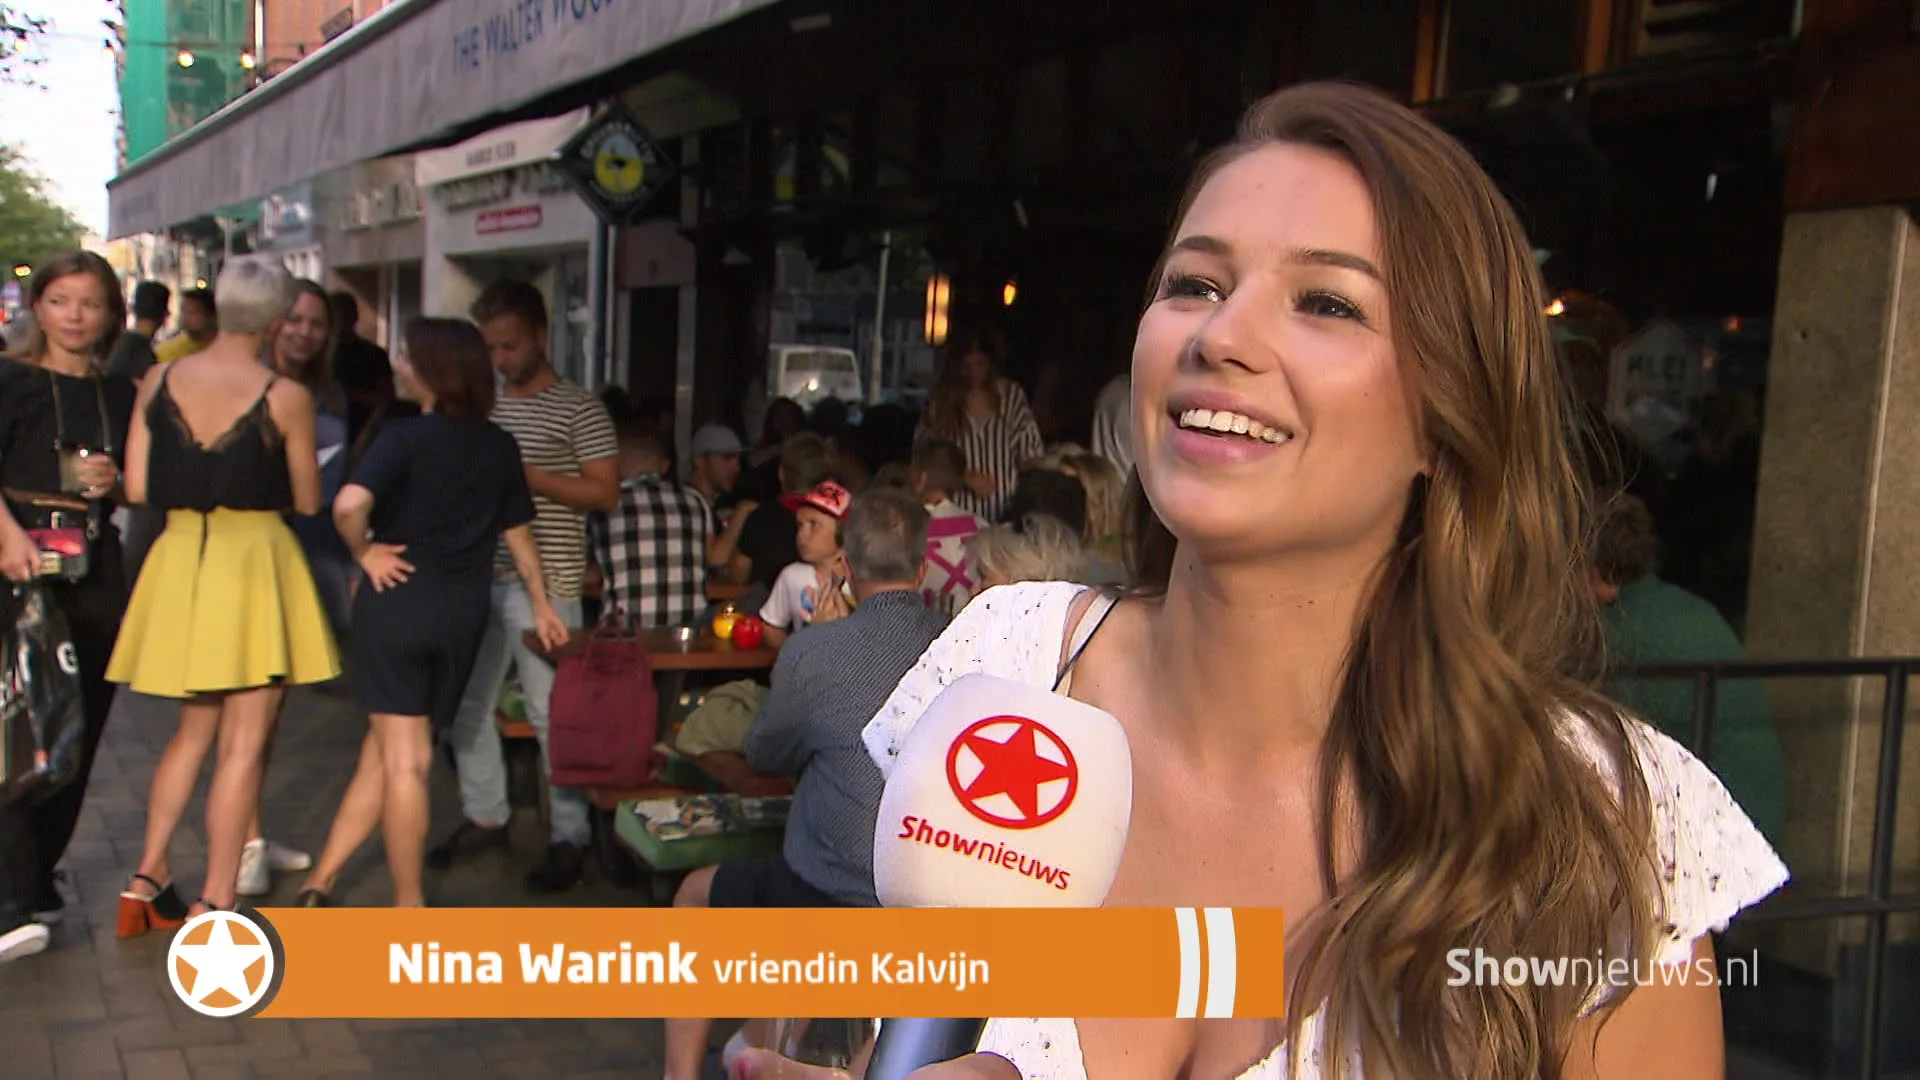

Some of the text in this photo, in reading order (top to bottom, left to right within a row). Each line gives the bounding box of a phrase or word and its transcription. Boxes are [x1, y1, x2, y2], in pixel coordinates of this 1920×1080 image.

[453, 25, 480, 73] THE
[484, 0, 543, 54] WALTER
[898, 815, 1071, 890] Shownieuws
